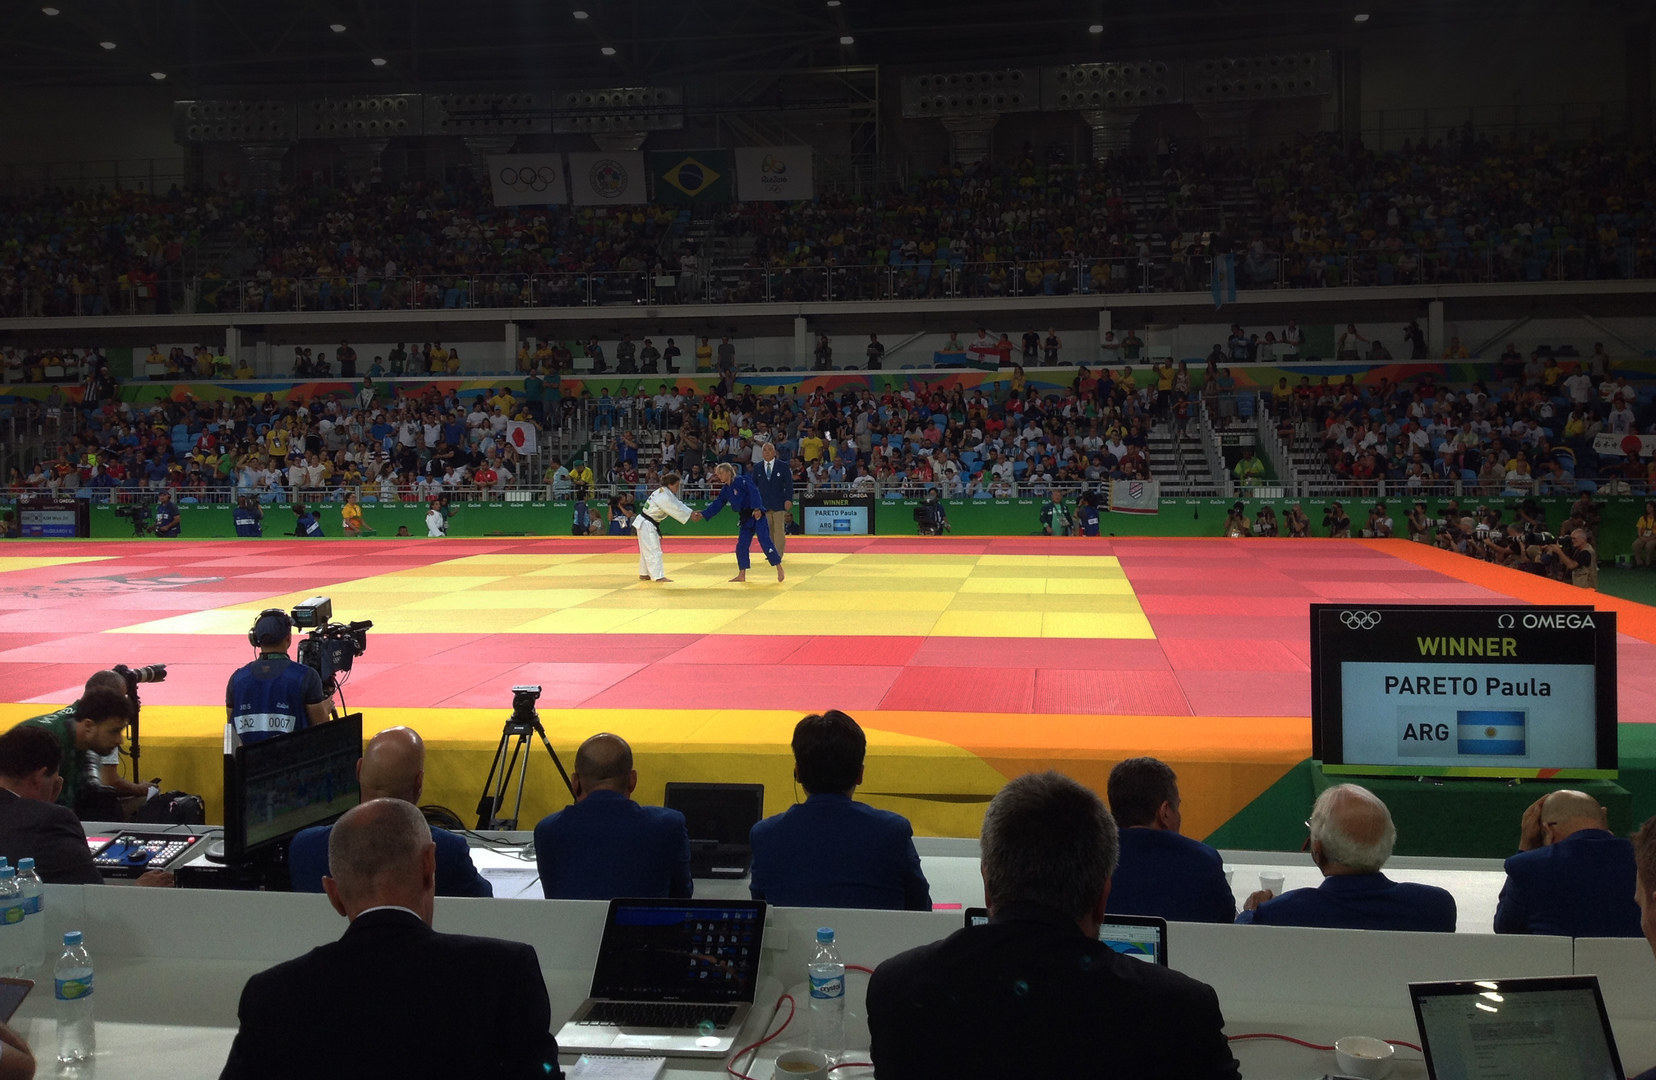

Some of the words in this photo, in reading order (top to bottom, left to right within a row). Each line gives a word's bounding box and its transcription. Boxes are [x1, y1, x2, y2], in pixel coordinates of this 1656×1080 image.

[1522, 613, 1596, 629] OMEGA
[1417, 636, 1518, 657] WINNER
[1384, 675, 1478, 696] PARETO
[1486, 677, 1551, 697] Paula
[269, 717, 290, 729] 0007
[1402, 723, 1449, 741] ARG
